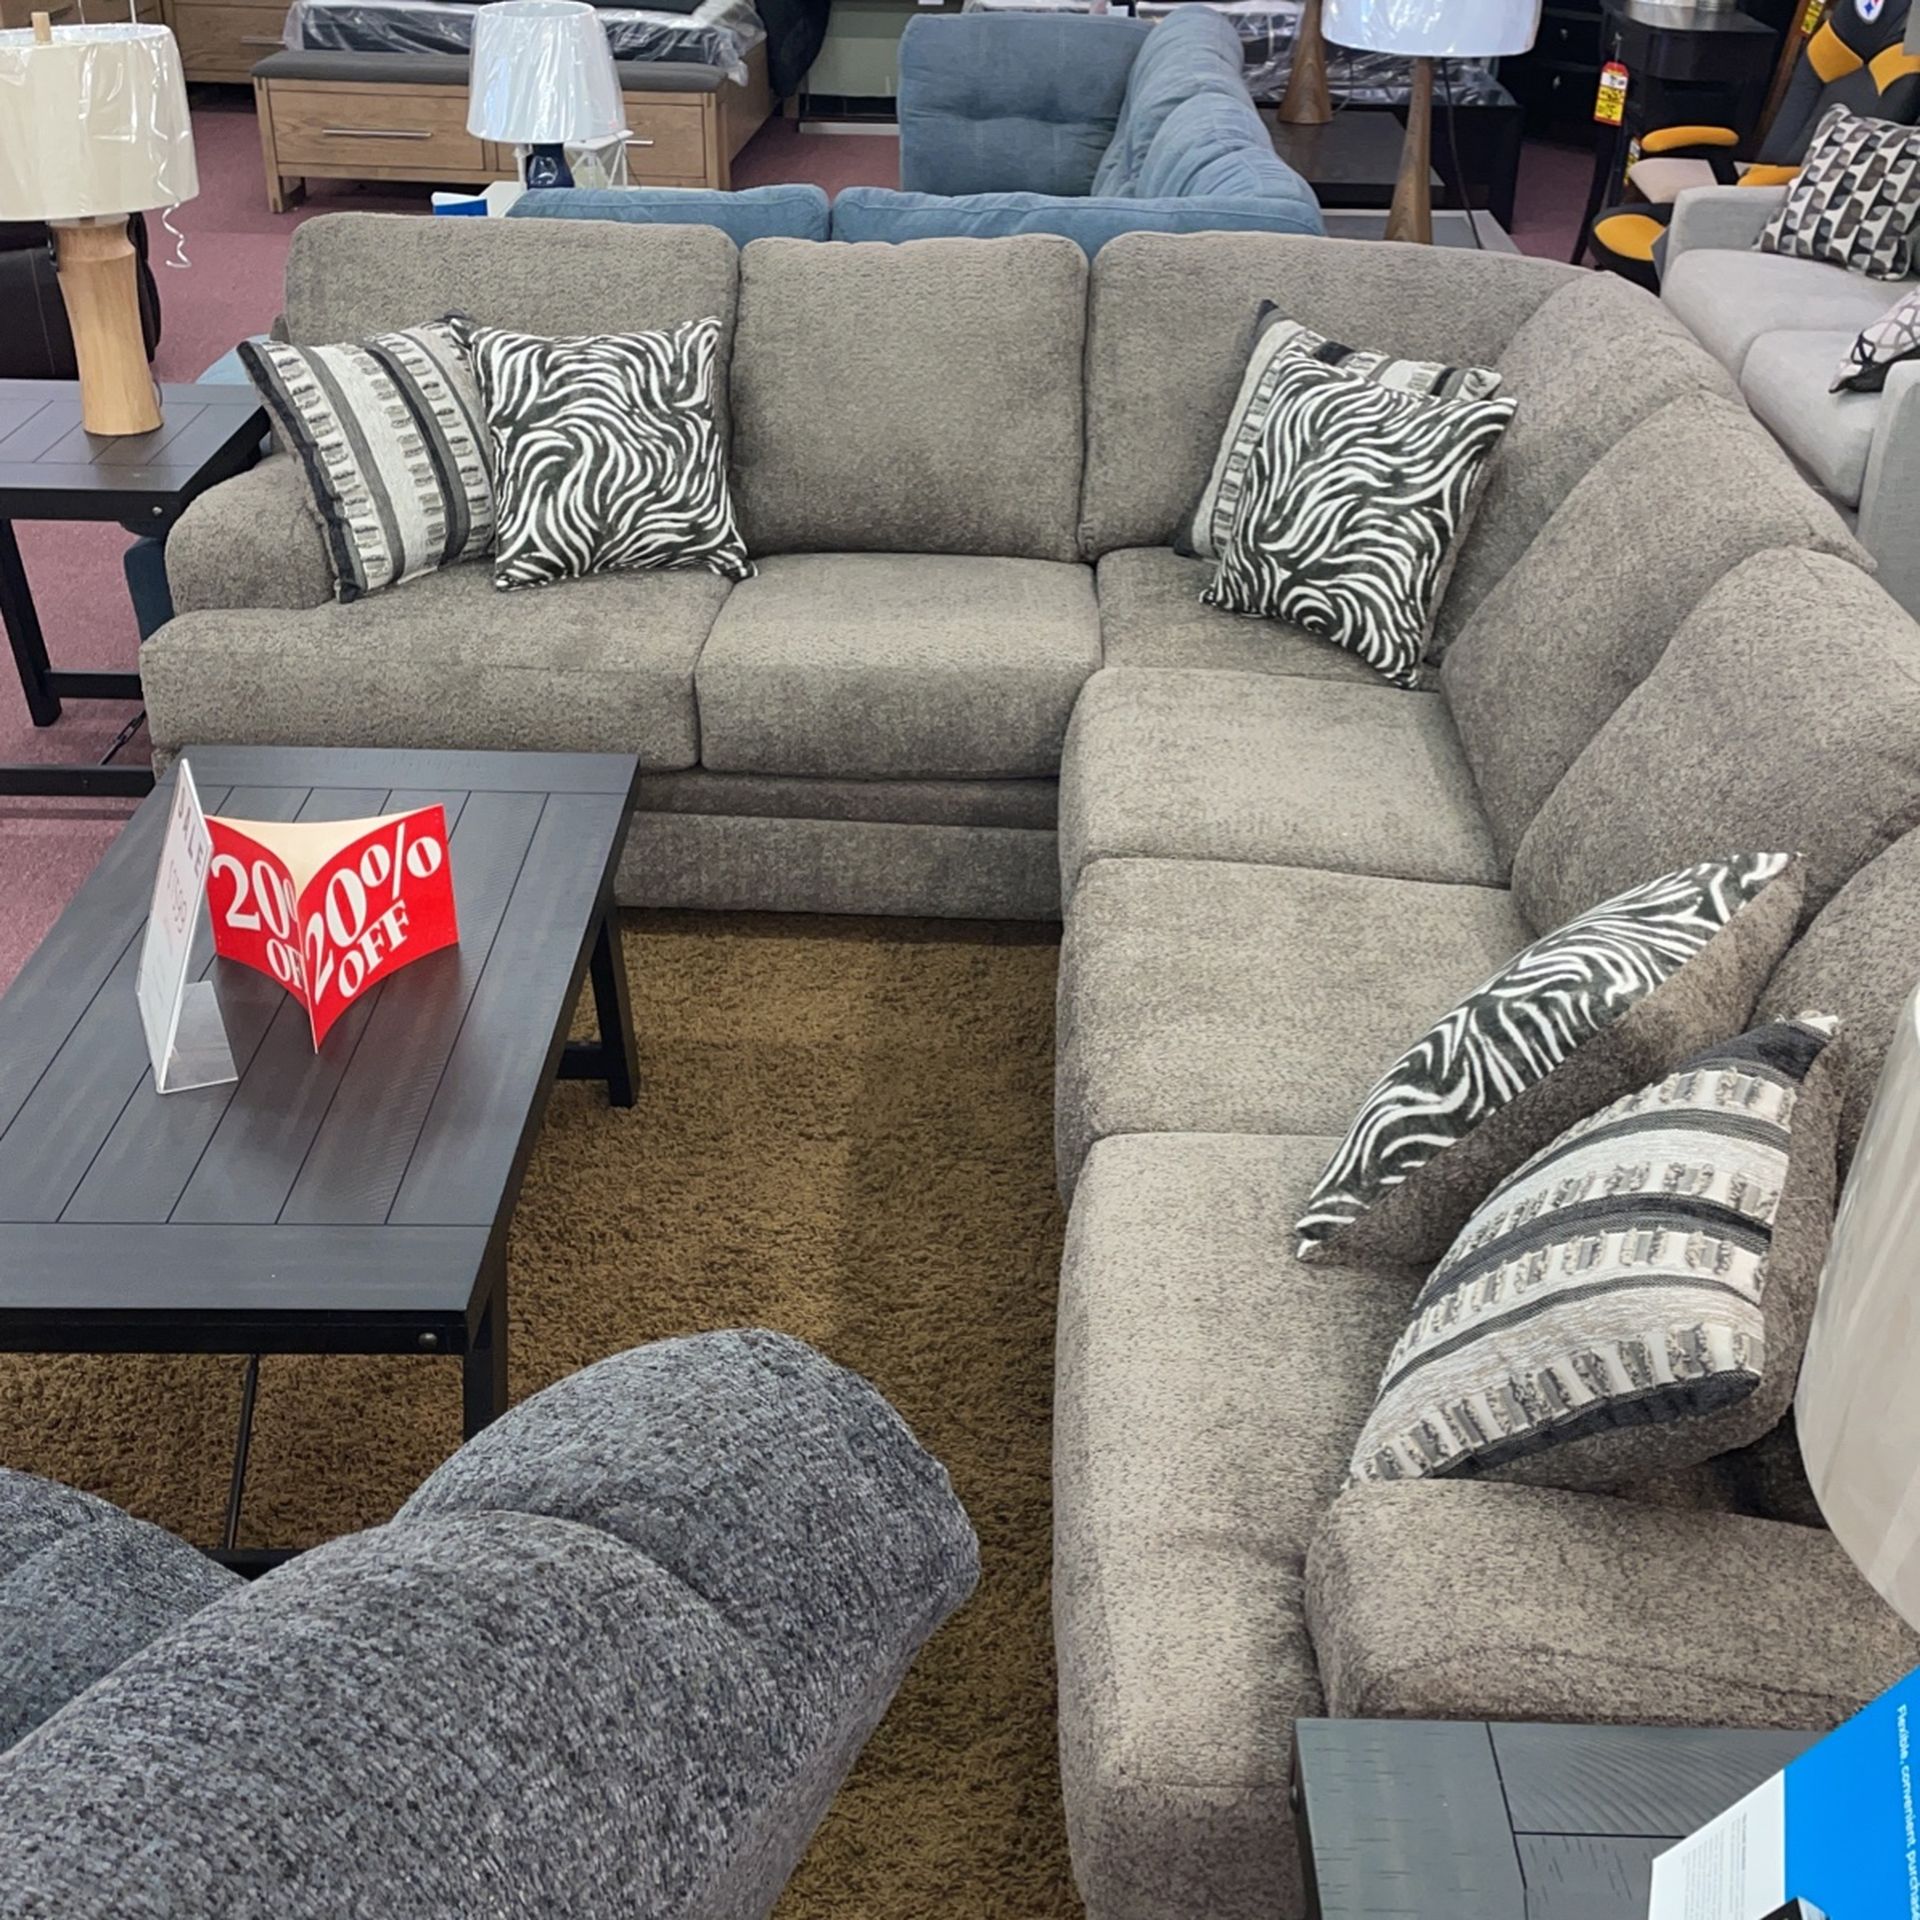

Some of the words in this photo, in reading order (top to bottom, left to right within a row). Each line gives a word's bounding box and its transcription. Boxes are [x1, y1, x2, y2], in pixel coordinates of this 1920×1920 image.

[305, 823, 442, 1005] 20%
[338, 900, 409, 998] OFF
[266, 938, 304, 989] OF
[1901, 1765, 1916, 1848] convenient
